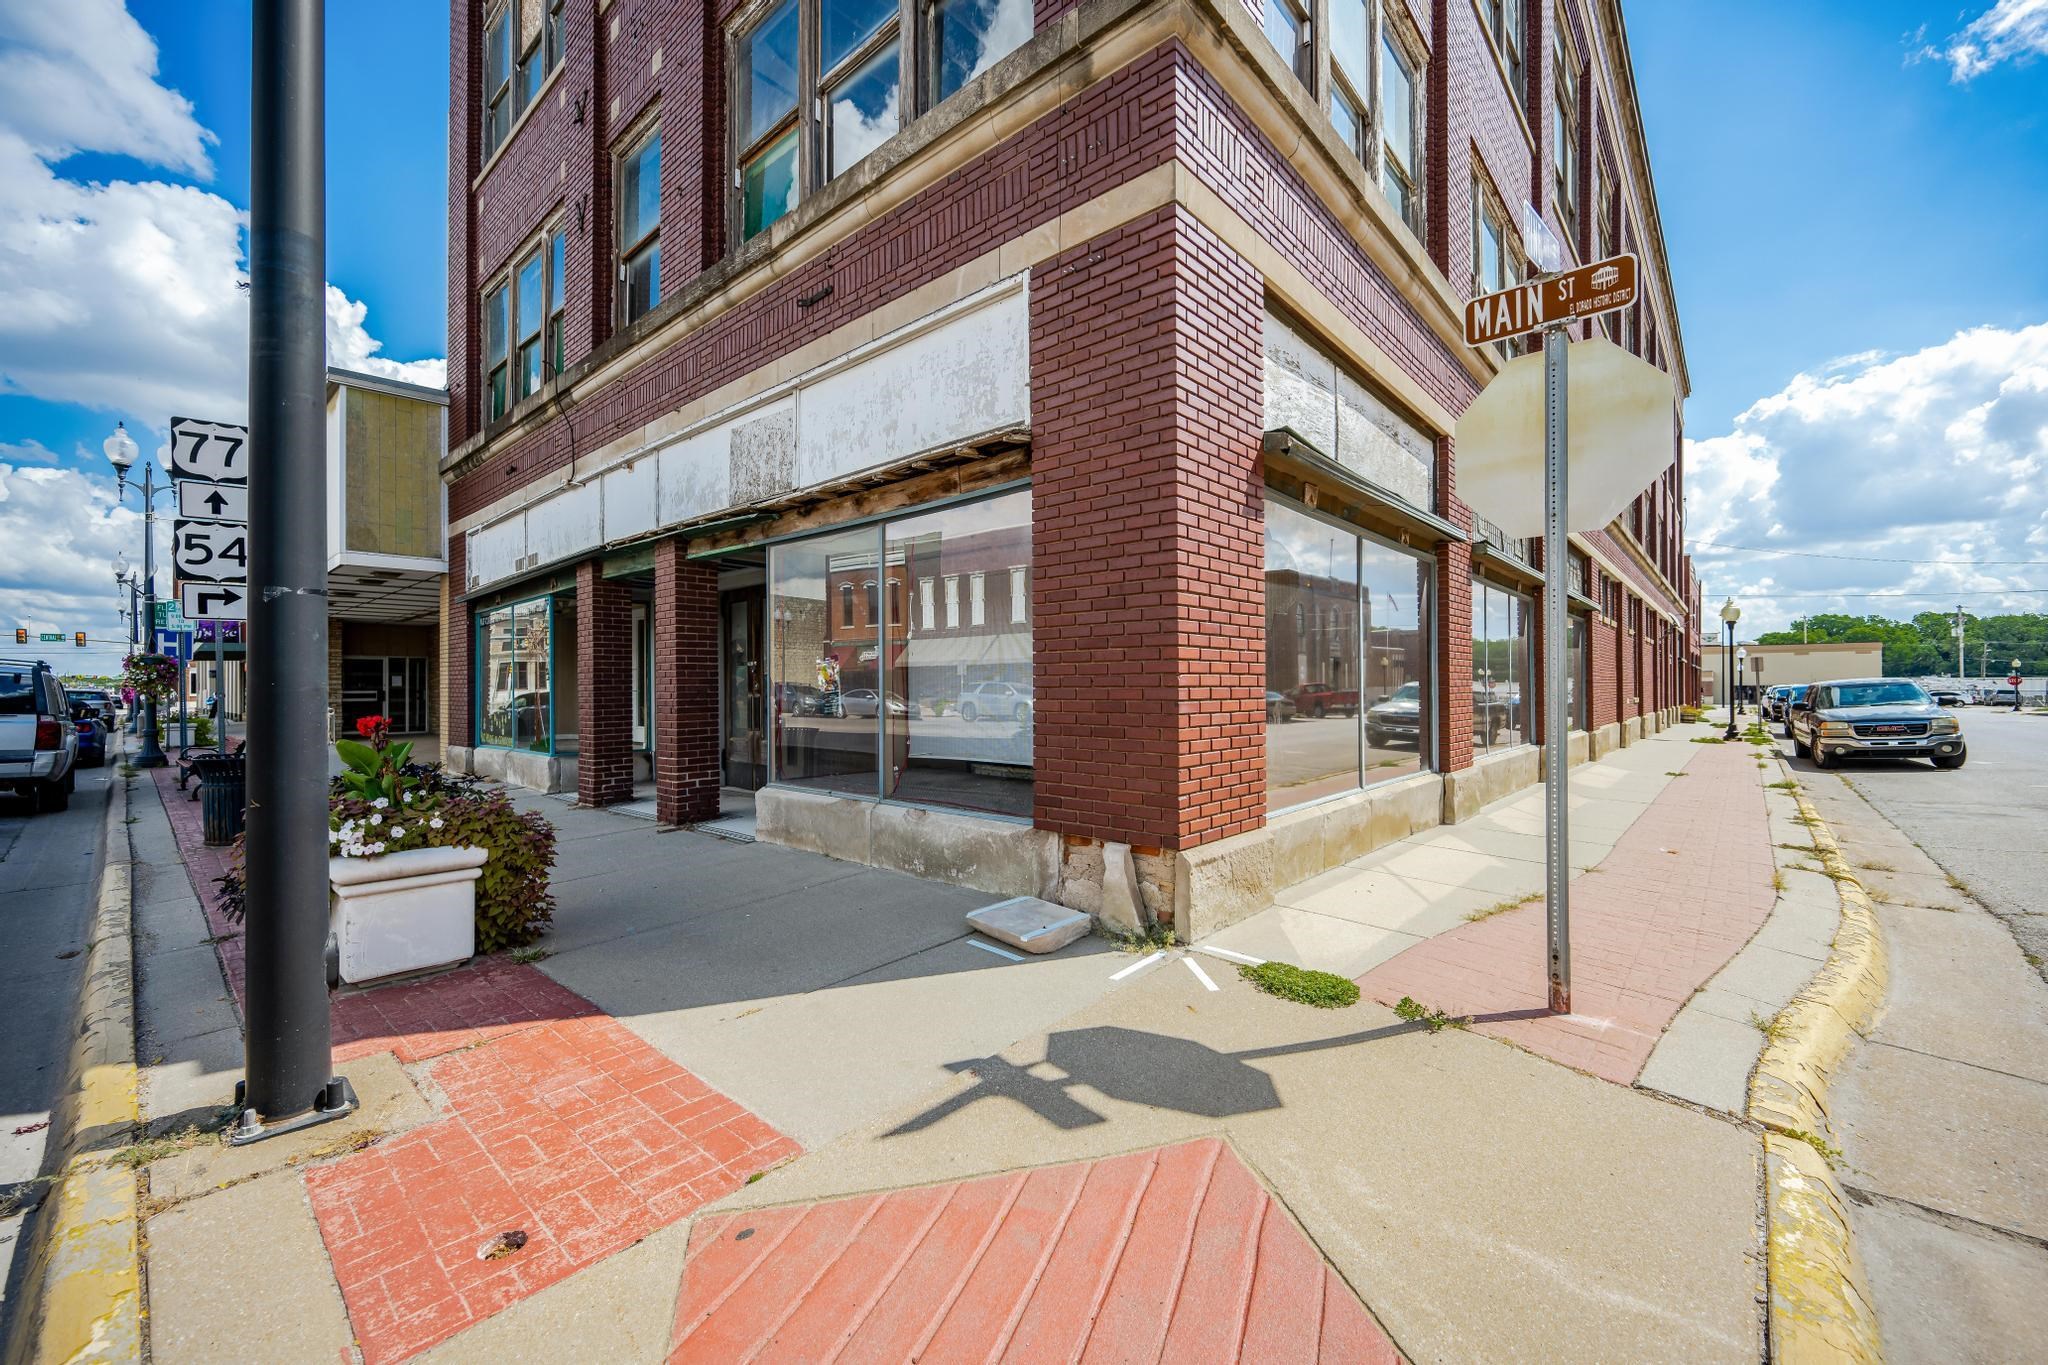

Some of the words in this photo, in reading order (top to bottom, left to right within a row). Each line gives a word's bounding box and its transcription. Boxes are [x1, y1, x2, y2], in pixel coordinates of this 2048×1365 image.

[1473, 284, 1544, 340] MAIN
[1558, 277, 1576, 301] ST
[1569, 303, 1576, 315] EL
[1576, 298, 1592, 314] DORADO
[1592, 293, 1612, 309] HISTORIC
[1612, 287, 1631, 304] DISTRICT
[178, 430, 243, 468] 77
[184, 533, 247, 568] 54
[168, 603, 175, 611] 2
